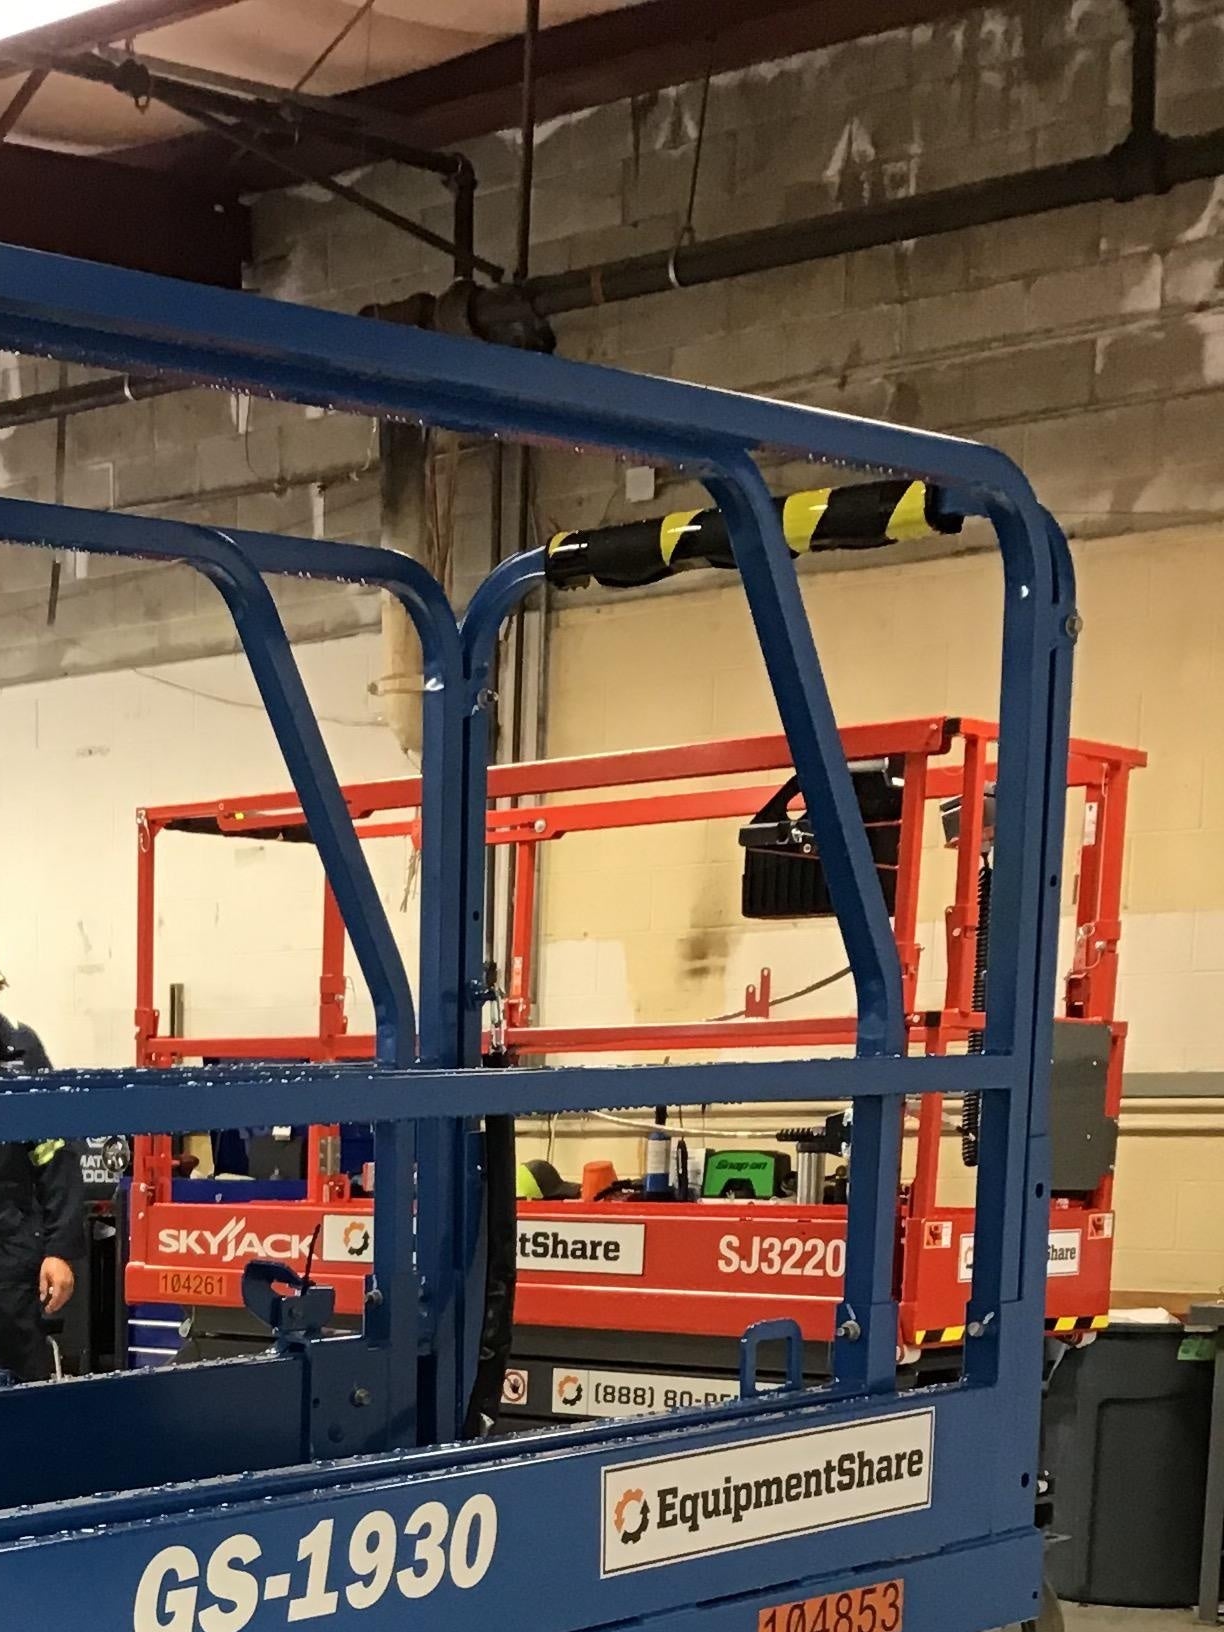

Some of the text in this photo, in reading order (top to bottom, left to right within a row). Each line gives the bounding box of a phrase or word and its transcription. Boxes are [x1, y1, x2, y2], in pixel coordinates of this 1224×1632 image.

[158, 1216, 318, 1262] SKYJACK
[718, 1234, 846, 1277] SJ3220
[161, 1273, 223, 1295] 104261
[595, 1382, 655, 1408] (888)
[657, 1448, 924, 1533] EquipmentShare
